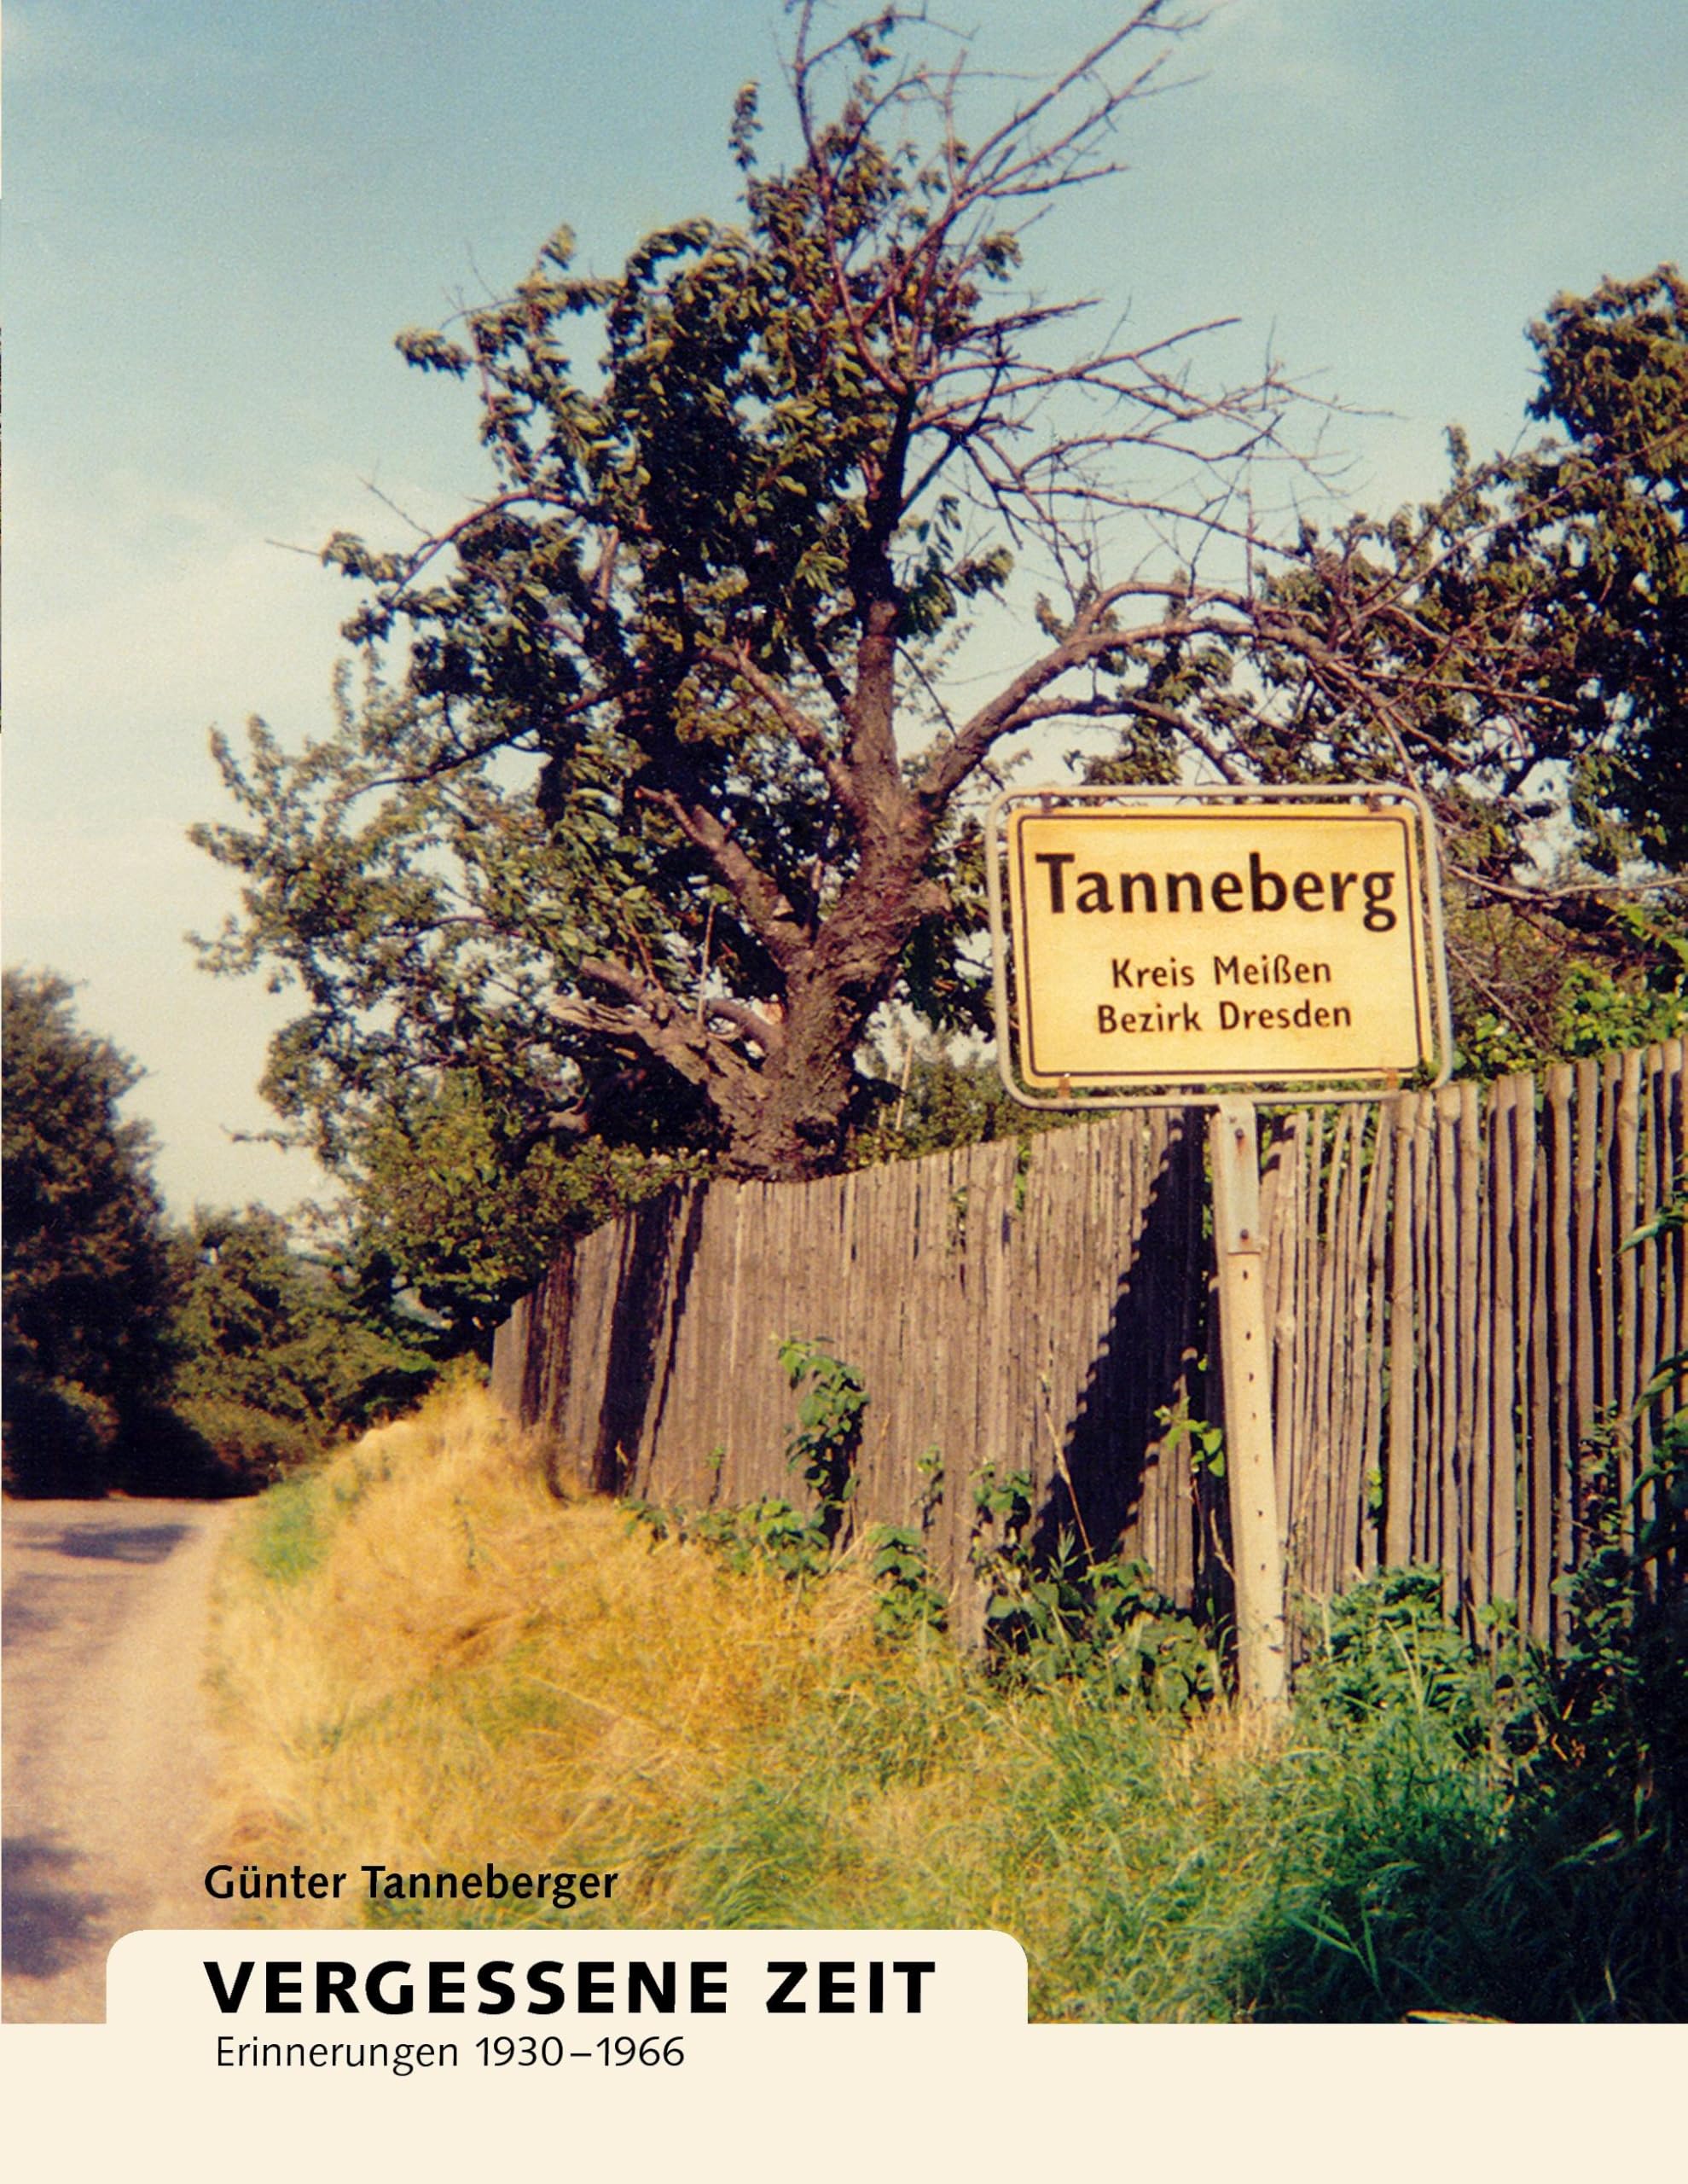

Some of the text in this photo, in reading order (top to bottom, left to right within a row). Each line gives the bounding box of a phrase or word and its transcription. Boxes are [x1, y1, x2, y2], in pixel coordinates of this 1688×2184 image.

[1035, 851, 1397, 932] Tanneberg
[1111, 954, 1332, 988] Kreis Meißen
[1098, 999, 1352, 1034] Bezirk Dresden
